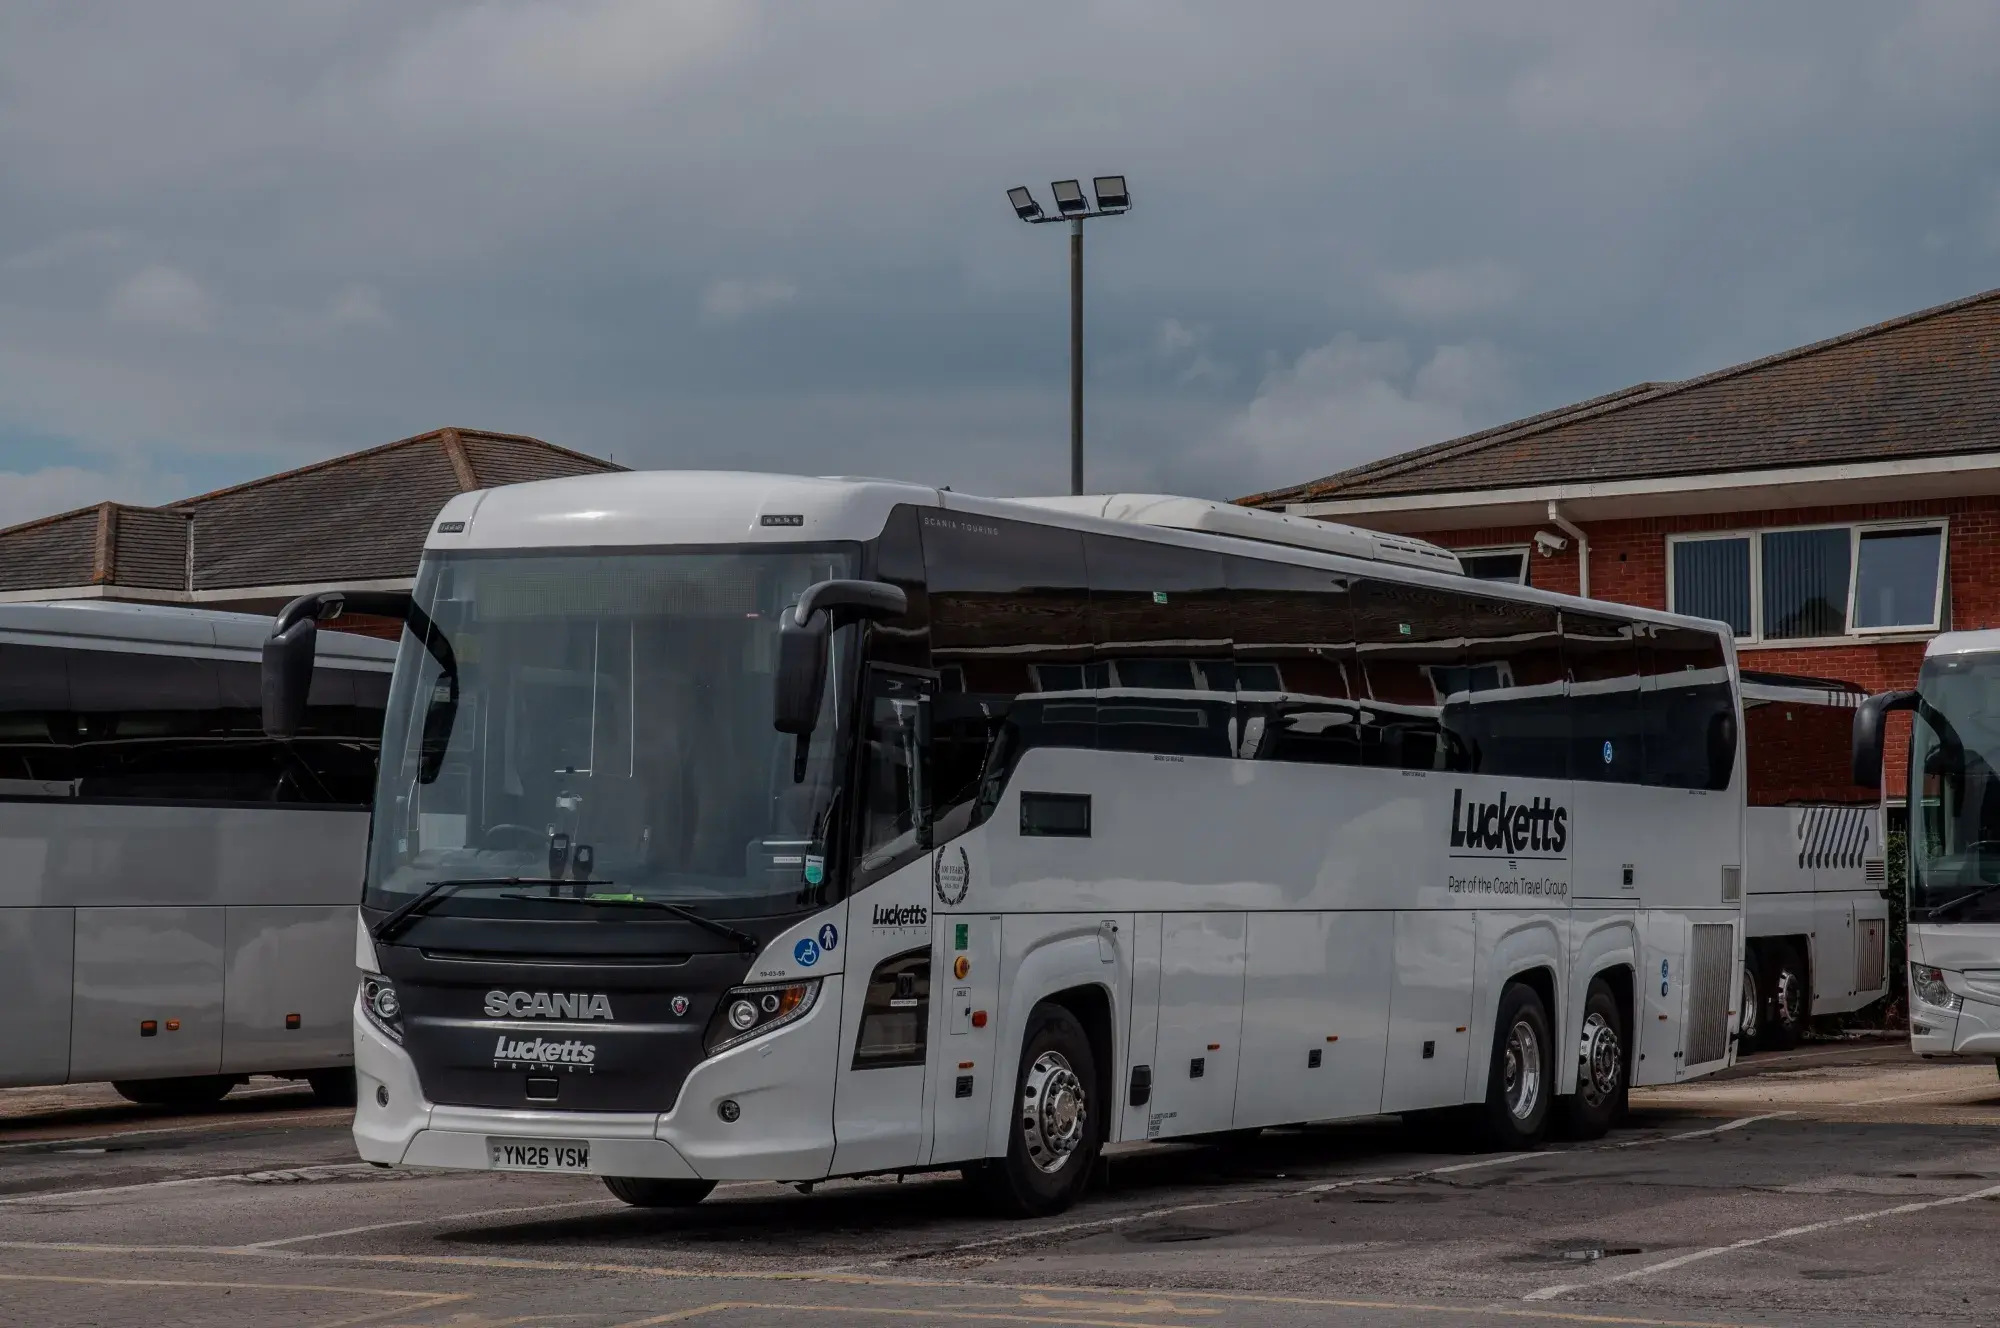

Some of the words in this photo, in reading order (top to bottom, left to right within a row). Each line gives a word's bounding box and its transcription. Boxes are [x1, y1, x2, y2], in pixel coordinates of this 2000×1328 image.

[924, 517, 957, 529] SCANIA
[961, 522, 999, 536] TOURING
[1450, 788, 1567, 854] Lucketts
[1448, 875, 1466, 893] Part
[1468, 875, 1477, 894] of
[1478, 876, 1492, 894] the
[1493, 877, 1519, 895] Coach
[1520, 878, 1543, 895] Travel
[1544, 878, 1567, 899] Group
[872, 903, 927, 926] Lucketts
[484, 990, 614, 1020] SCANIA
[494, 1035, 596, 1063] Lucketts
[493, 1062, 594, 1074] TRAVEL
[504, 1145, 549, 1166] YN26
[555, 1148, 588, 1168] VSM
